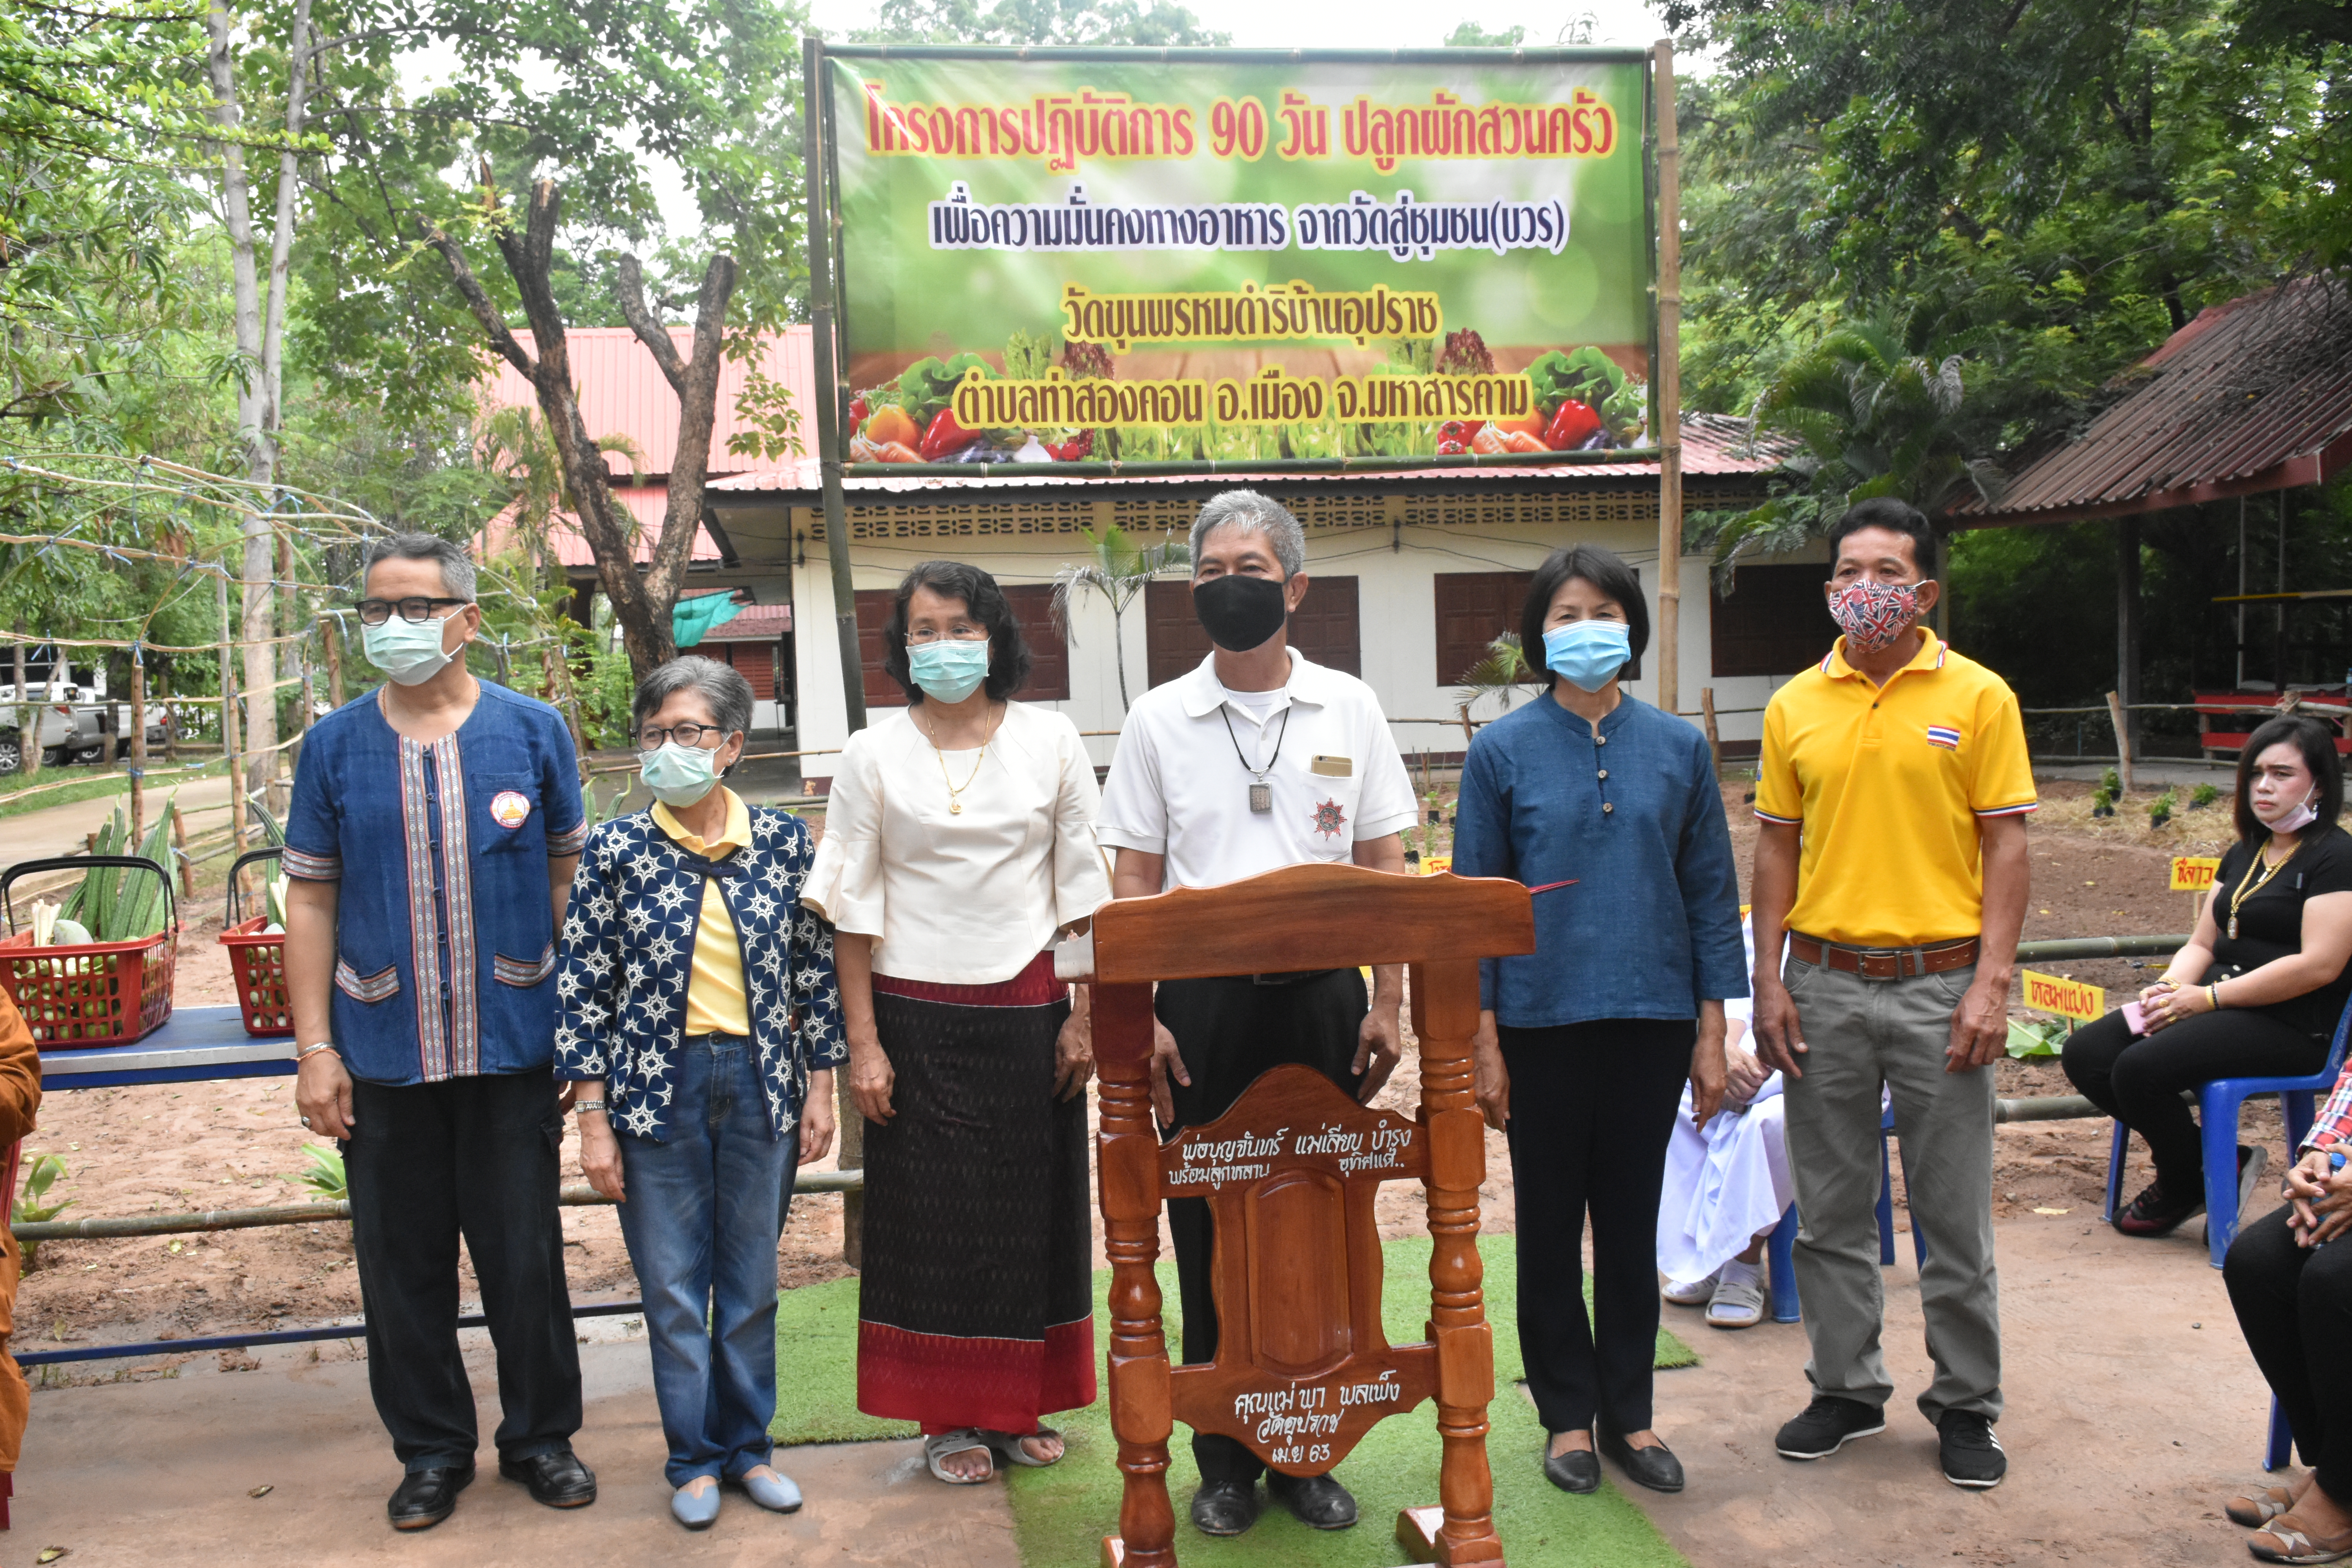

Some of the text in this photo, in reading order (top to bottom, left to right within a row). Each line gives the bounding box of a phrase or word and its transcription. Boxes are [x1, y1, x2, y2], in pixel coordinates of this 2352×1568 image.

[865, 84, 1613, 171] โครงการปฏิบัติการ 90 วัน ปลูกผักสวนครัว
[933, 185, 1564, 256] เพื่อความมั่นคงทางอาหาร จากวัดสู่ชุมชน(บวร)
[1065, 285, 1437, 350] วัดขุนพรหมดำริบ้านอุปราช
[958, 369, 1528, 424] ตำบลท่าสองคอน อ.เมือง จ.มหาสารคาม
[2031, 979, 2094, 1016] หอมแบ่ง
[1234, 1381, 1295, 1424] คุณแม่
[1309, 1443, 1330, 1463] 63
